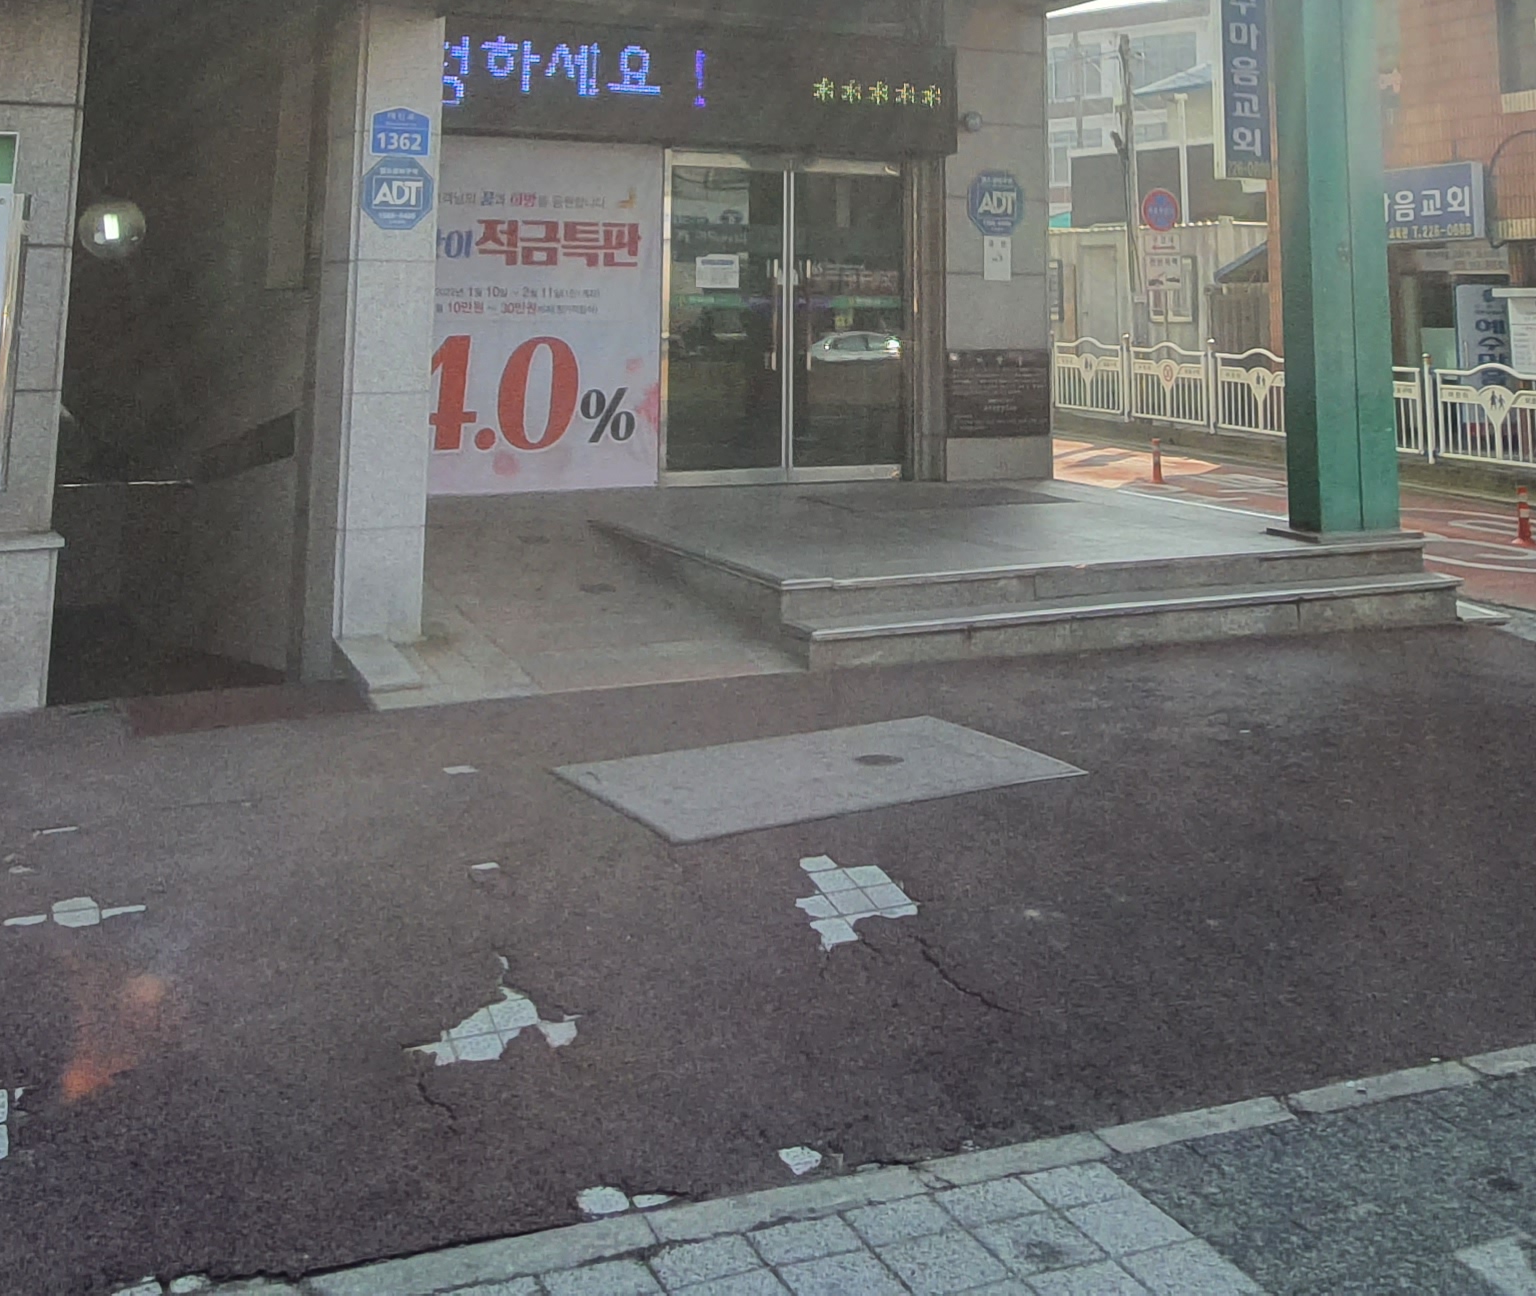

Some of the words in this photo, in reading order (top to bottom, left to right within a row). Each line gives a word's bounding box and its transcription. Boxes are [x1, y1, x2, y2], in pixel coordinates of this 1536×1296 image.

[376, 132, 422, 151] 1362
[372, 180, 424, 206] ADT
[978, 190, 1017, 215] ADT
[474, 218, 643, 268] 적금특판
